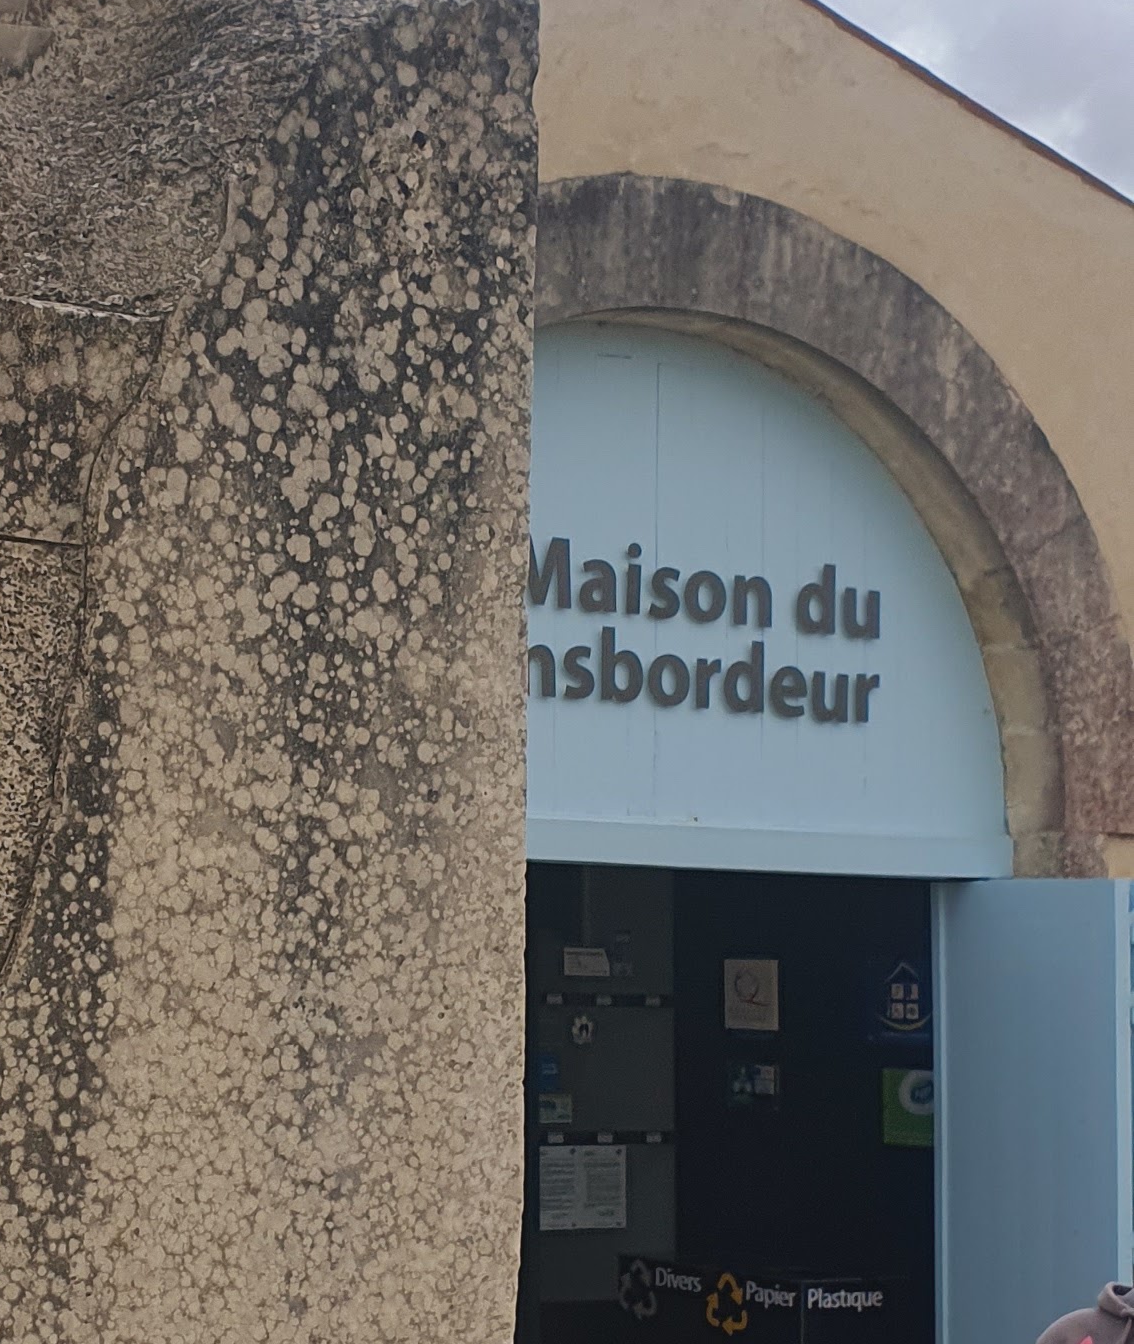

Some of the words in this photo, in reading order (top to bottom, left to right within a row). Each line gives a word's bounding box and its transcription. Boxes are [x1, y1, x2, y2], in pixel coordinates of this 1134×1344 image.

[529, 536, 772, 628] Maison
[795, 564, 880, 639] du
[655, 1267, 702, 1293] Divers
[745, 1280, 796, 1308] Papier
[807, 1287, 884, 1312] Plastique
